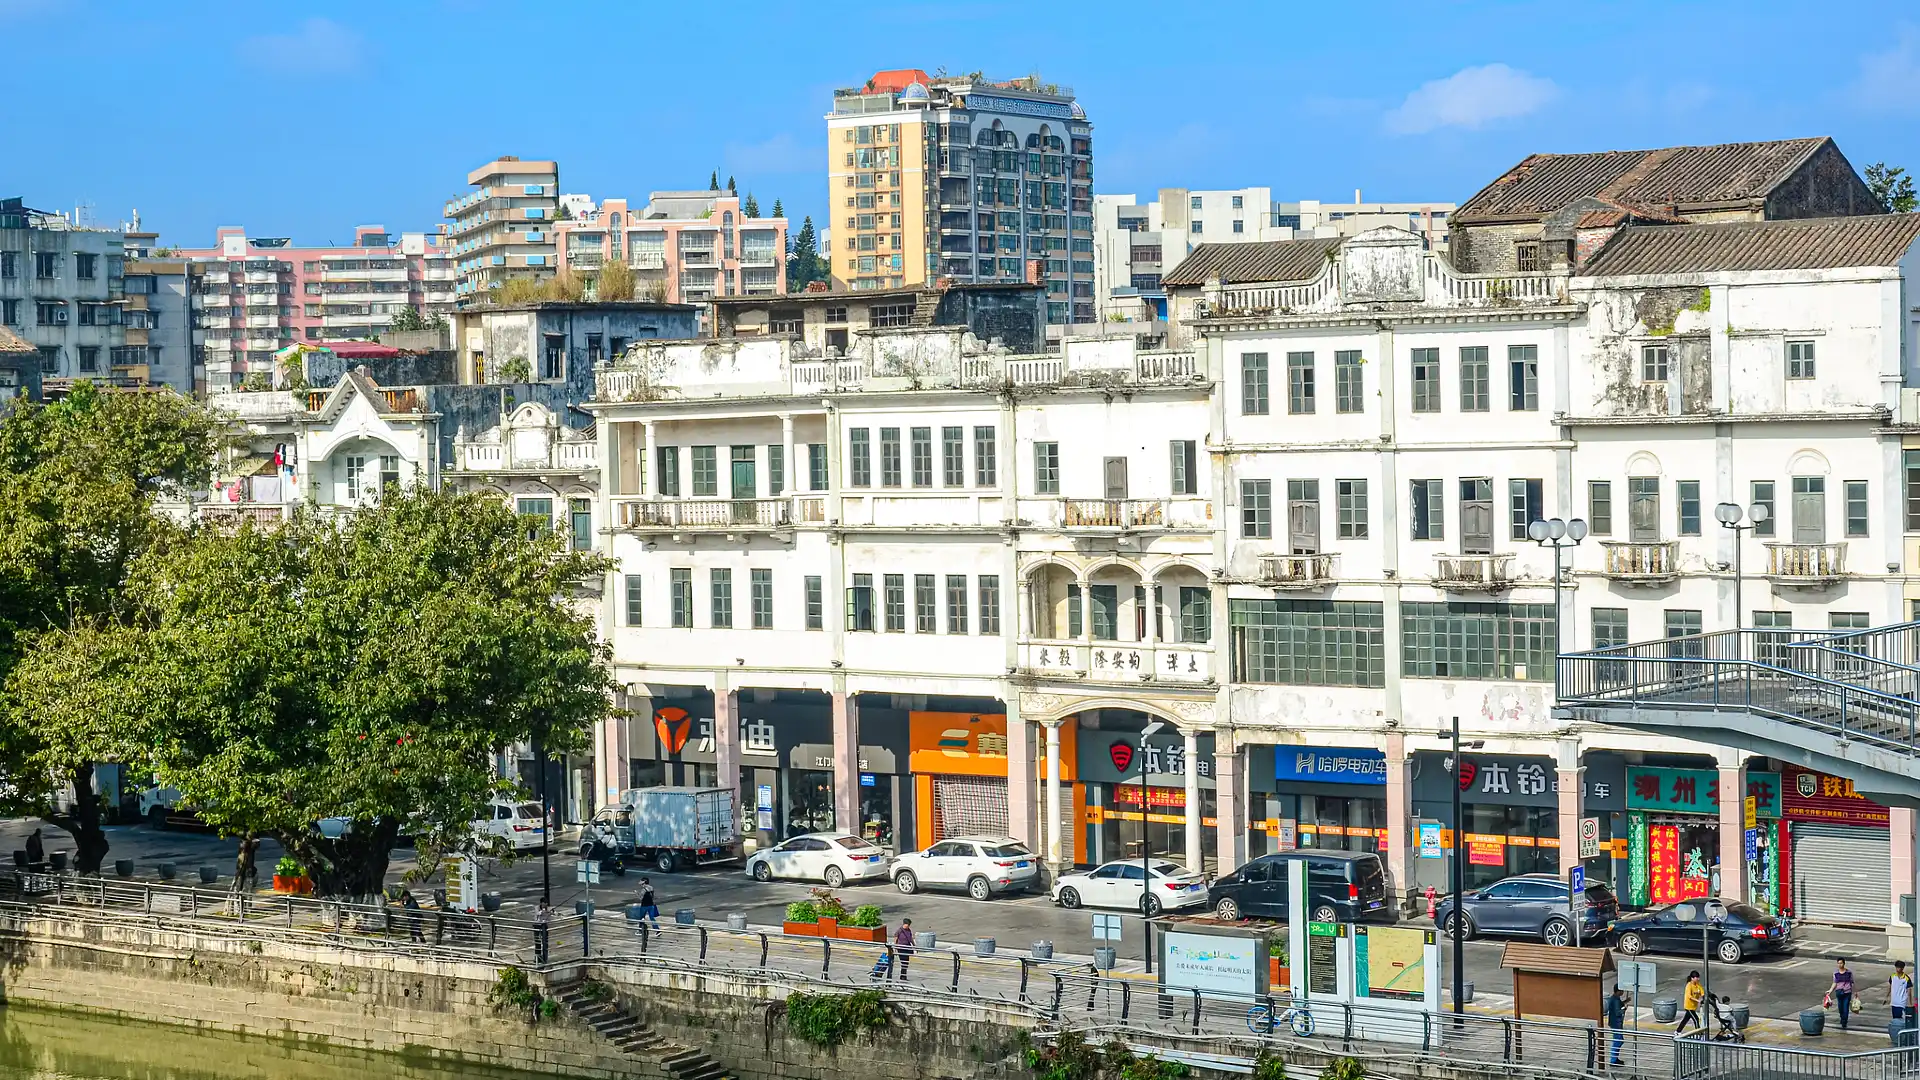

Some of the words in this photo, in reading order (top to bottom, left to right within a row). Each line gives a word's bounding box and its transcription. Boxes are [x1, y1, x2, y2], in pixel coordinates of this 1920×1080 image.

[1800, 785, 1814, 793] TCH
[1584, 824, 1594, 835] 30
[1574, 872, 1580, 889] P
[1684, 880, 1705, 893] 江门
